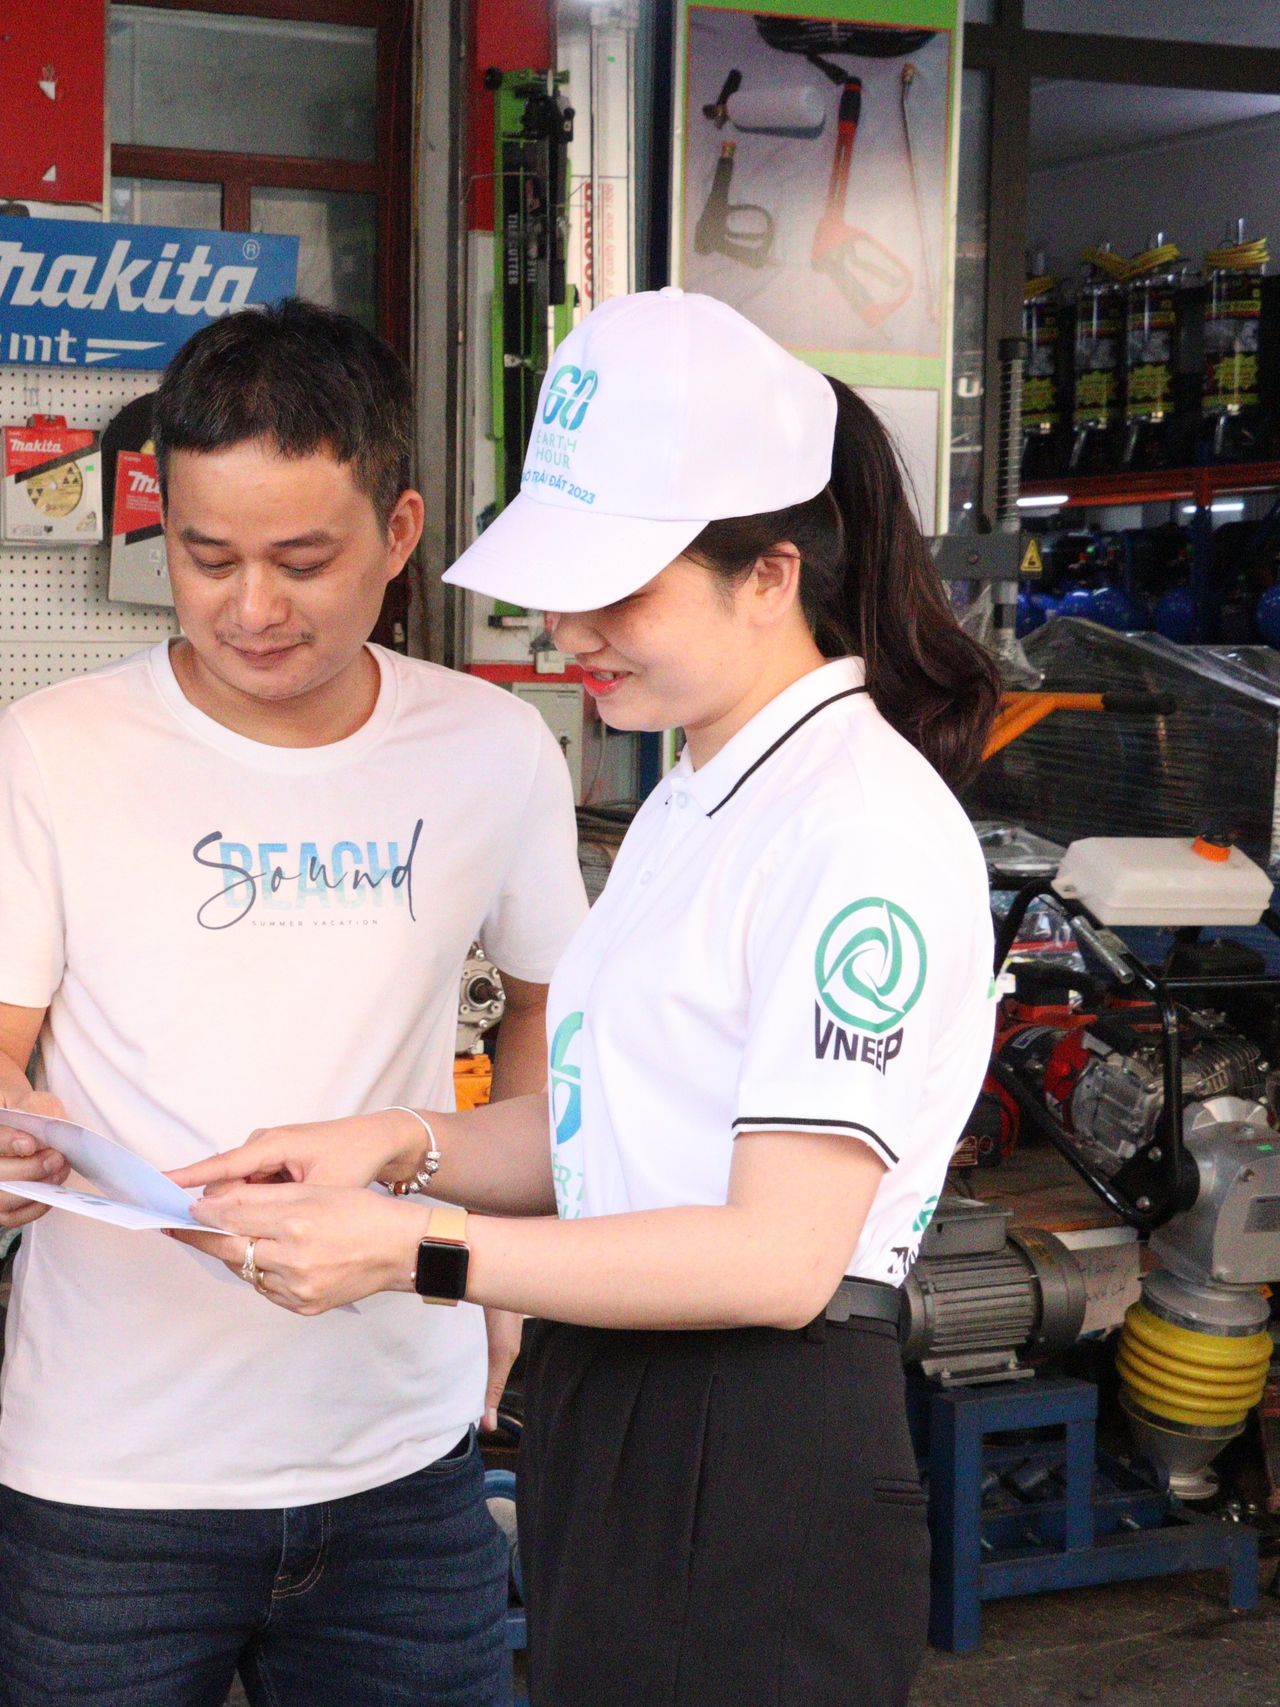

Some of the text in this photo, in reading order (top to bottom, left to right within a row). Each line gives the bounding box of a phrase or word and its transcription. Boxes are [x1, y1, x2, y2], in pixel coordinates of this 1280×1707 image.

[9, 328, 77, 364] mt
[536, 430, 577, 454] EARTH
[535, 446, 571, 470] HOUR
[567, 483, 597, 505] 2023
[192, 818, 424, 930] Sound
[251, 918, 379, 927] SUMMER VACATION
[814, 997, 905, 1077] VNEEP
